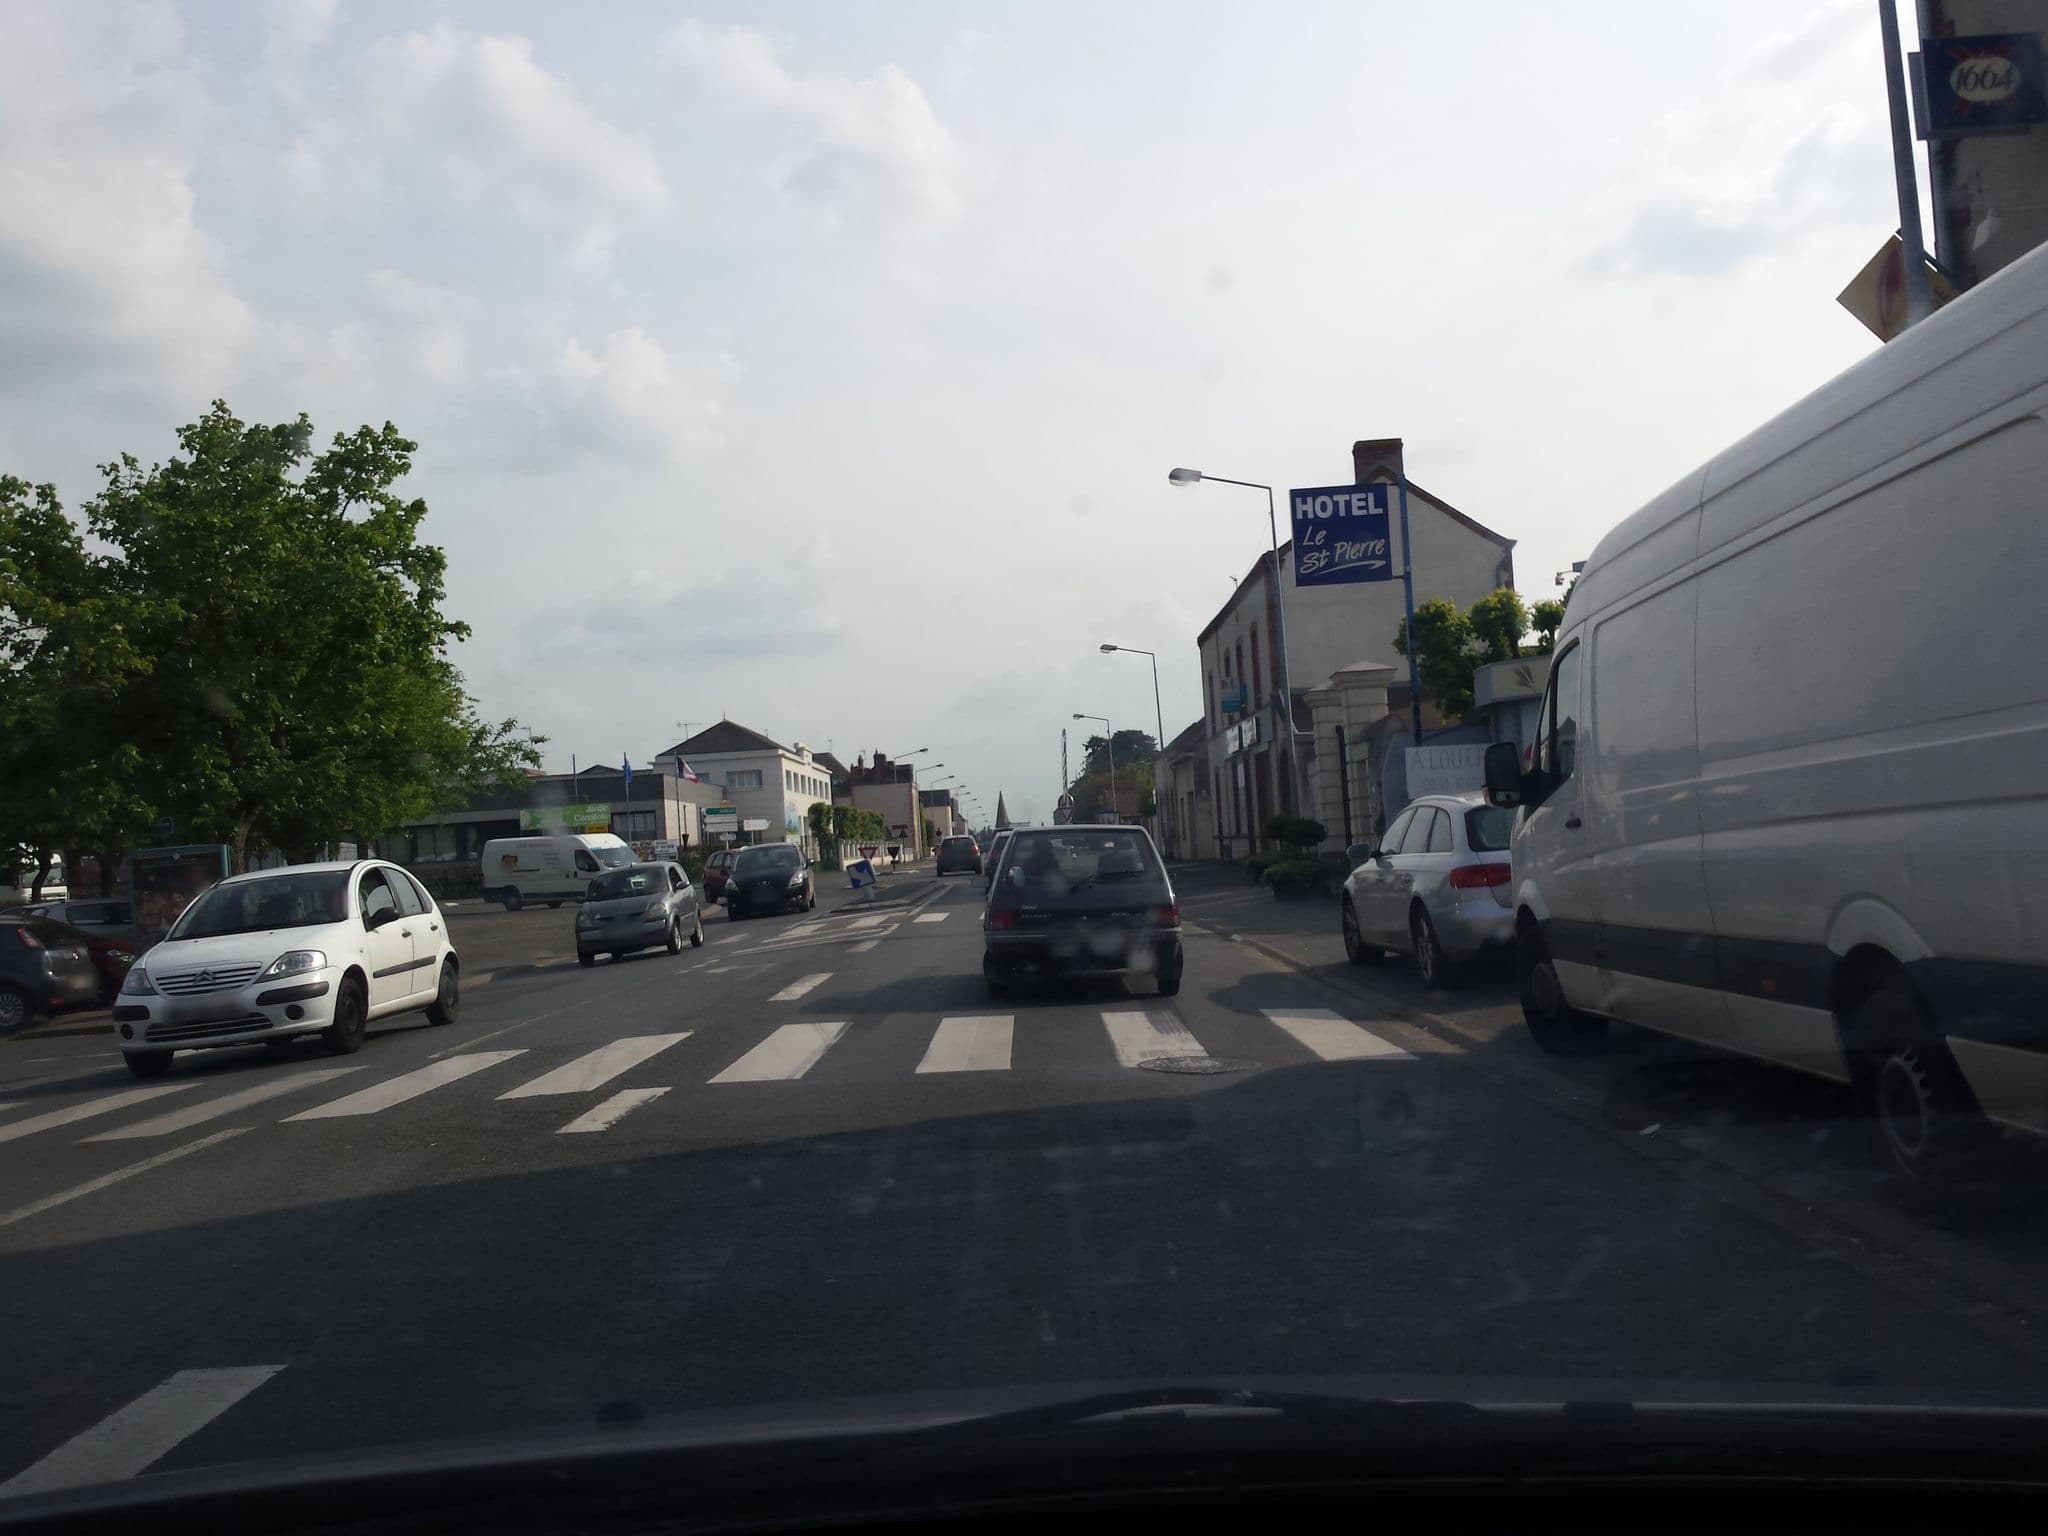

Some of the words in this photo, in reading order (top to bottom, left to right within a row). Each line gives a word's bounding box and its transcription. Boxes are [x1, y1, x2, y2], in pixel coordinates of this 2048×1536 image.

[1956, 63, 2012, 92] 1664
[1295, 492, 1384, 520] HOTEL
[1302, 526, 1327, 546] Le
[1300, 549, 1330, 574] St
[1334, 539, 1385, 562] Pierre
